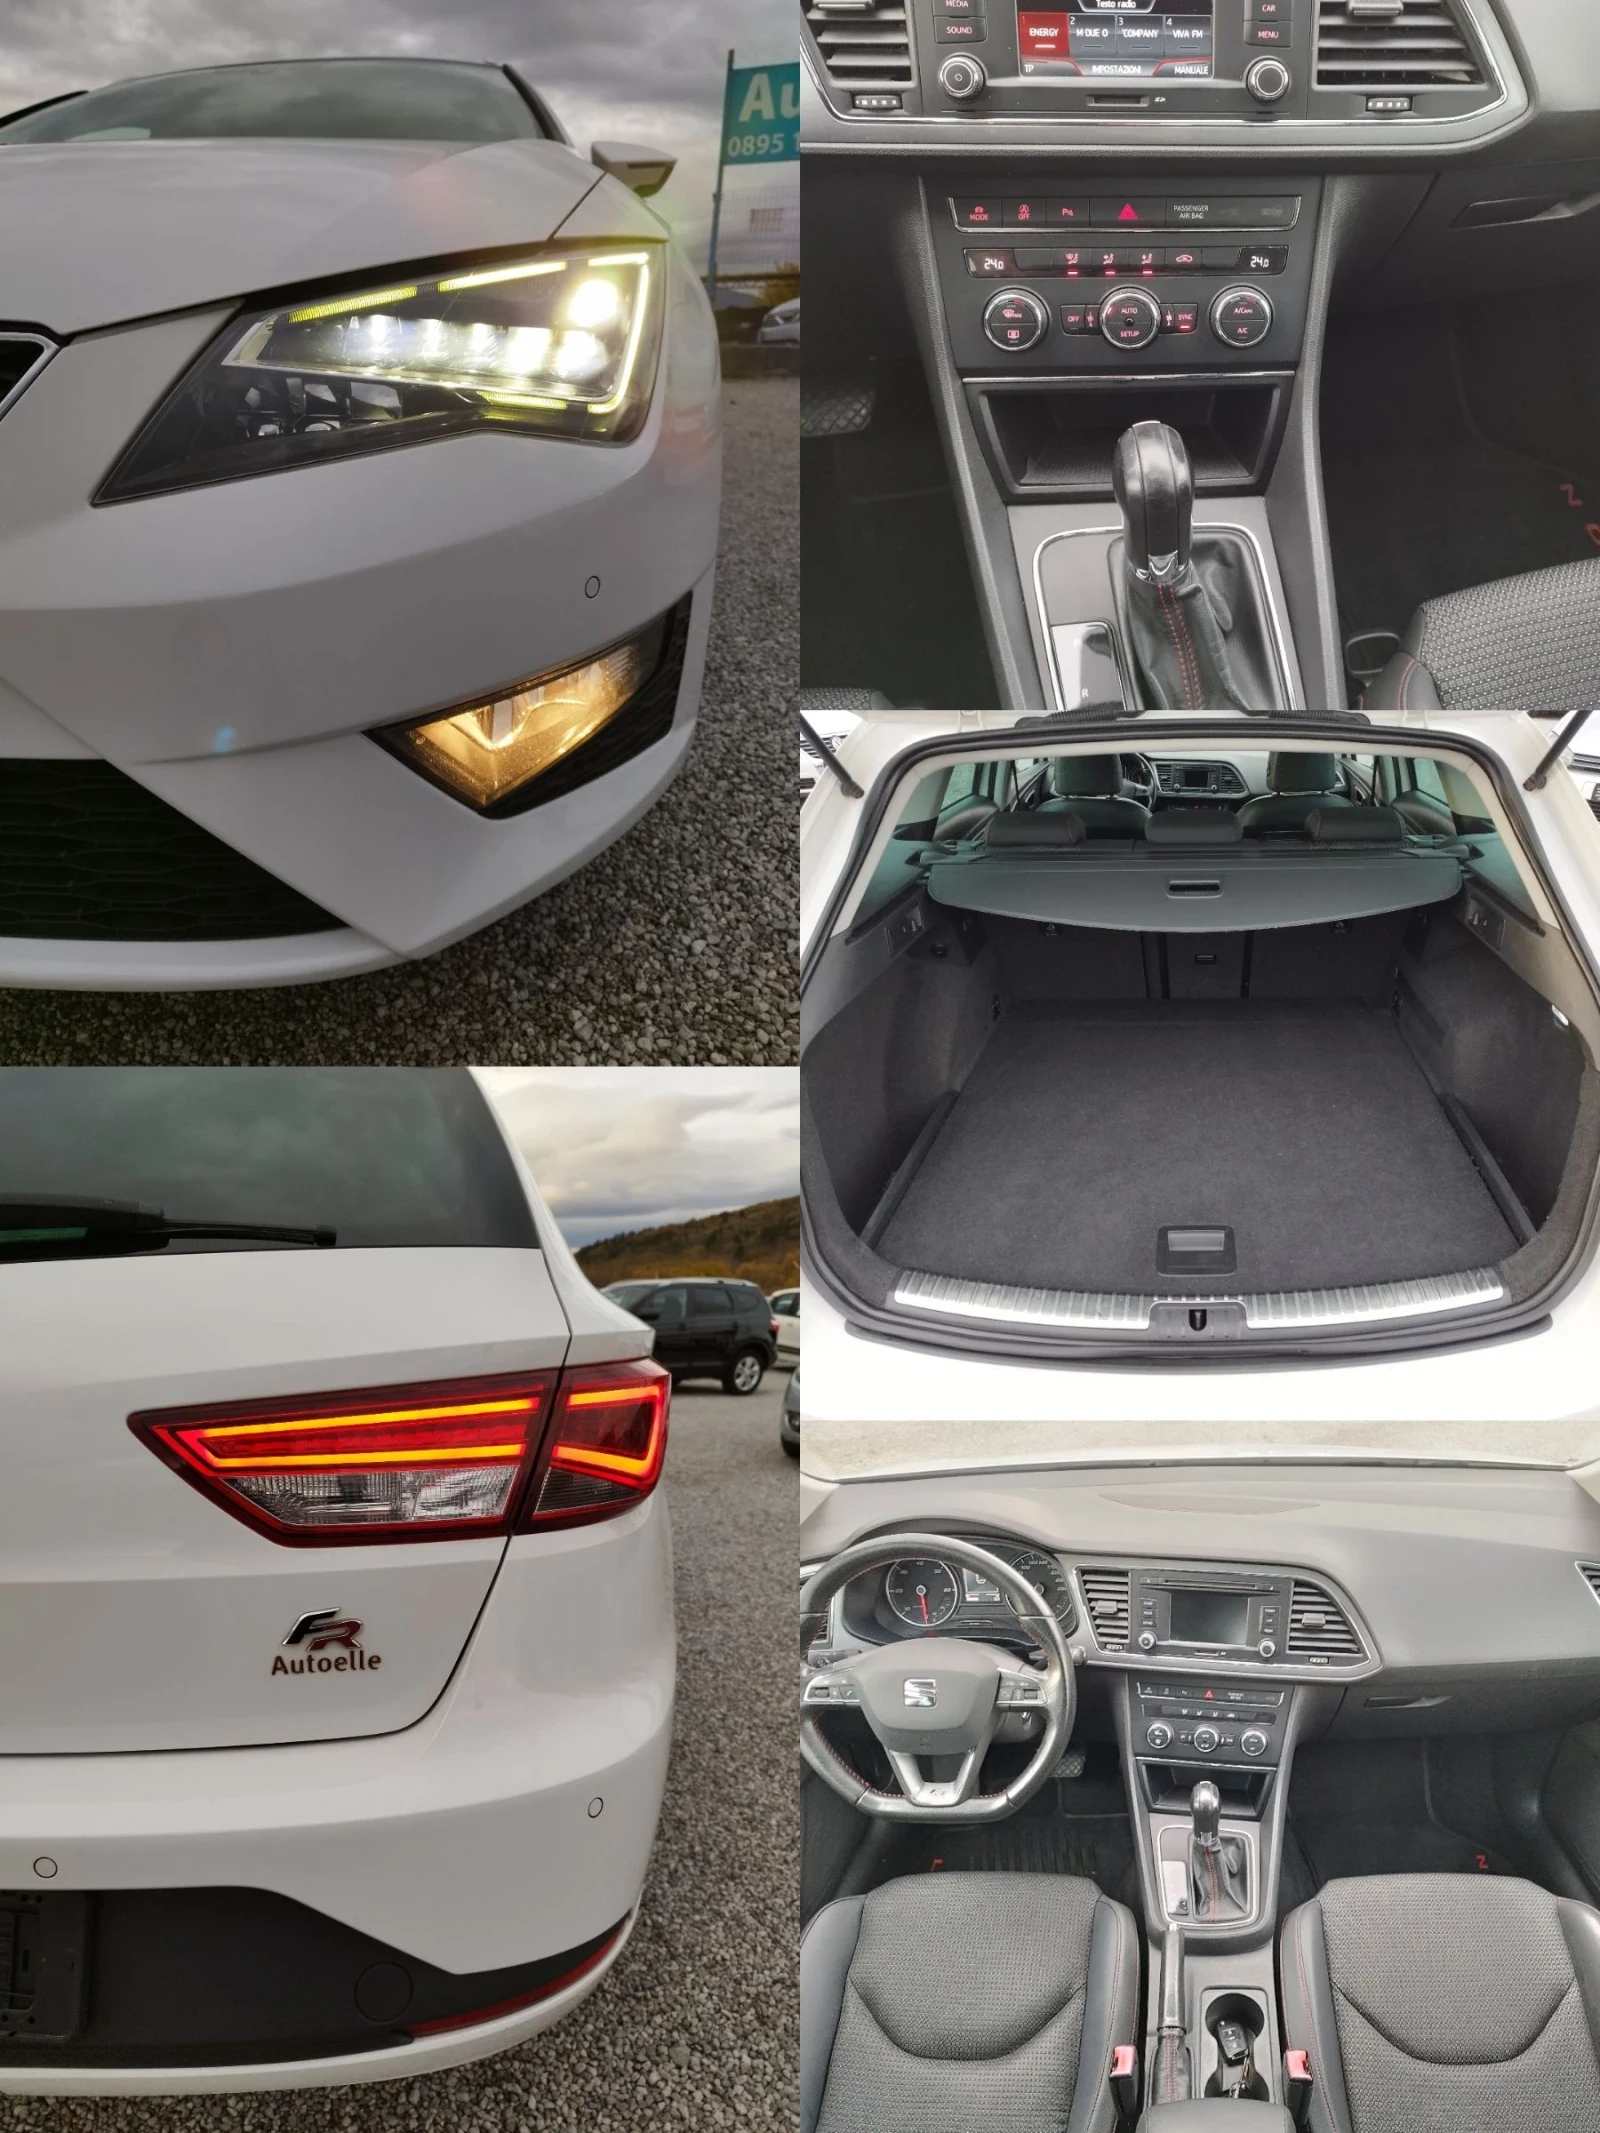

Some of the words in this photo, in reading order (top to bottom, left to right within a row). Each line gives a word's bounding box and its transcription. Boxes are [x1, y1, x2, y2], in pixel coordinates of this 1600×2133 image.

[1096, 0, 1116, 8] Testo
[1117, 0, 1136, 8] radio
[1262, 4, 1276, 12] CAR
[1070, 16, 1076, 25] 2
[1118, 16, 1124, 26] 3
[1166, 18, 1173, 26] 4
[946, 26, 973, 34] SOUND
[1029, 28, 1059, 37] ENERGY
[1076, 28, 1084, 37] M
[1085, 28, 1100, 37] DUE
[1172, 29, 1190, 38] VIVA
[1191, 29, 1203, 38] FM
[1258, 30, 1279, 39] MENU
[1024, 64, 1034, 73] TP
[1092, 64, 1142, 74] IMPOSTAZIONI
[1174, 66, 1209, 75] MANUALE
[738, 73, 800, 122] Au
[727, 133, 784, 157] 0895
[969, 213, 989, 221] MODE
[1191, 212, 1204, 220] BAG
[1121, 307, 1138, 315] AUTO
[1067, 315, 1080, 323] OFF
[1178, 313, 1194, 321] SYNC
[1120, 330, 1140, 338] SETUP
[1237, 326, 1249, 335] A/C
[1081, 688, 1089, 698] R
[281, 1606, 363, 1651] FR
[271, 1649, 382, 1676] Autoelle
